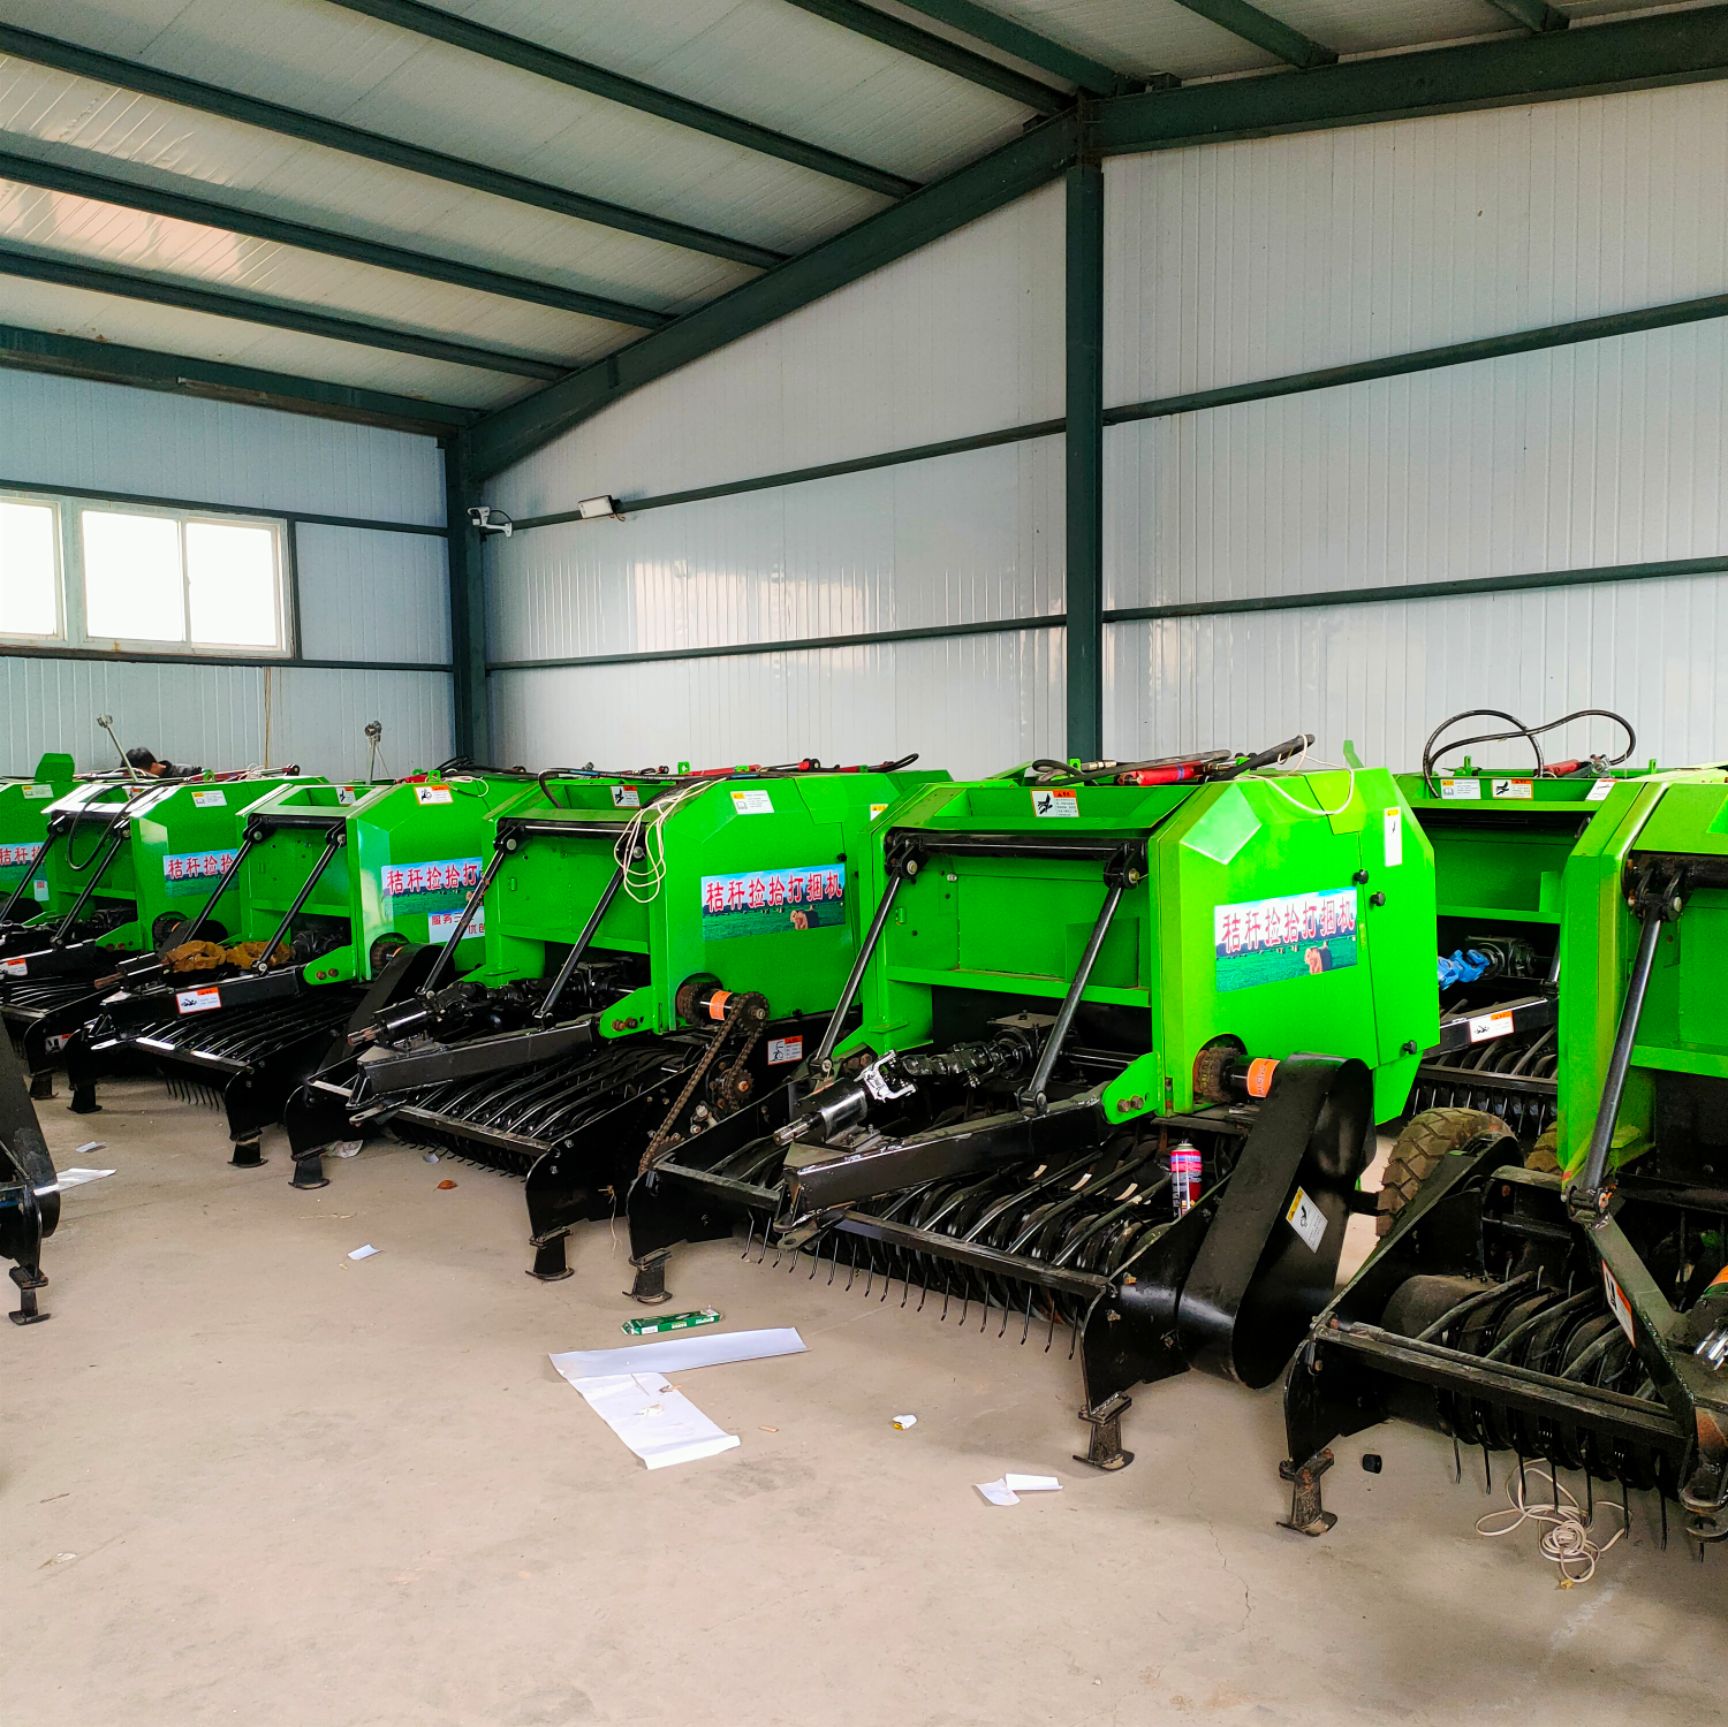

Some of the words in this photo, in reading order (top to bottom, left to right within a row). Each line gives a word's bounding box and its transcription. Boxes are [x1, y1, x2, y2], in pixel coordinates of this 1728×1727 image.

[386, 863, 483, 896] 秸秆捡拾打
[706, 870, 843, 913] 秸秆捡拾打捆机
[1221, 896, 1356, 954] 秸秆捡拾打捆机
